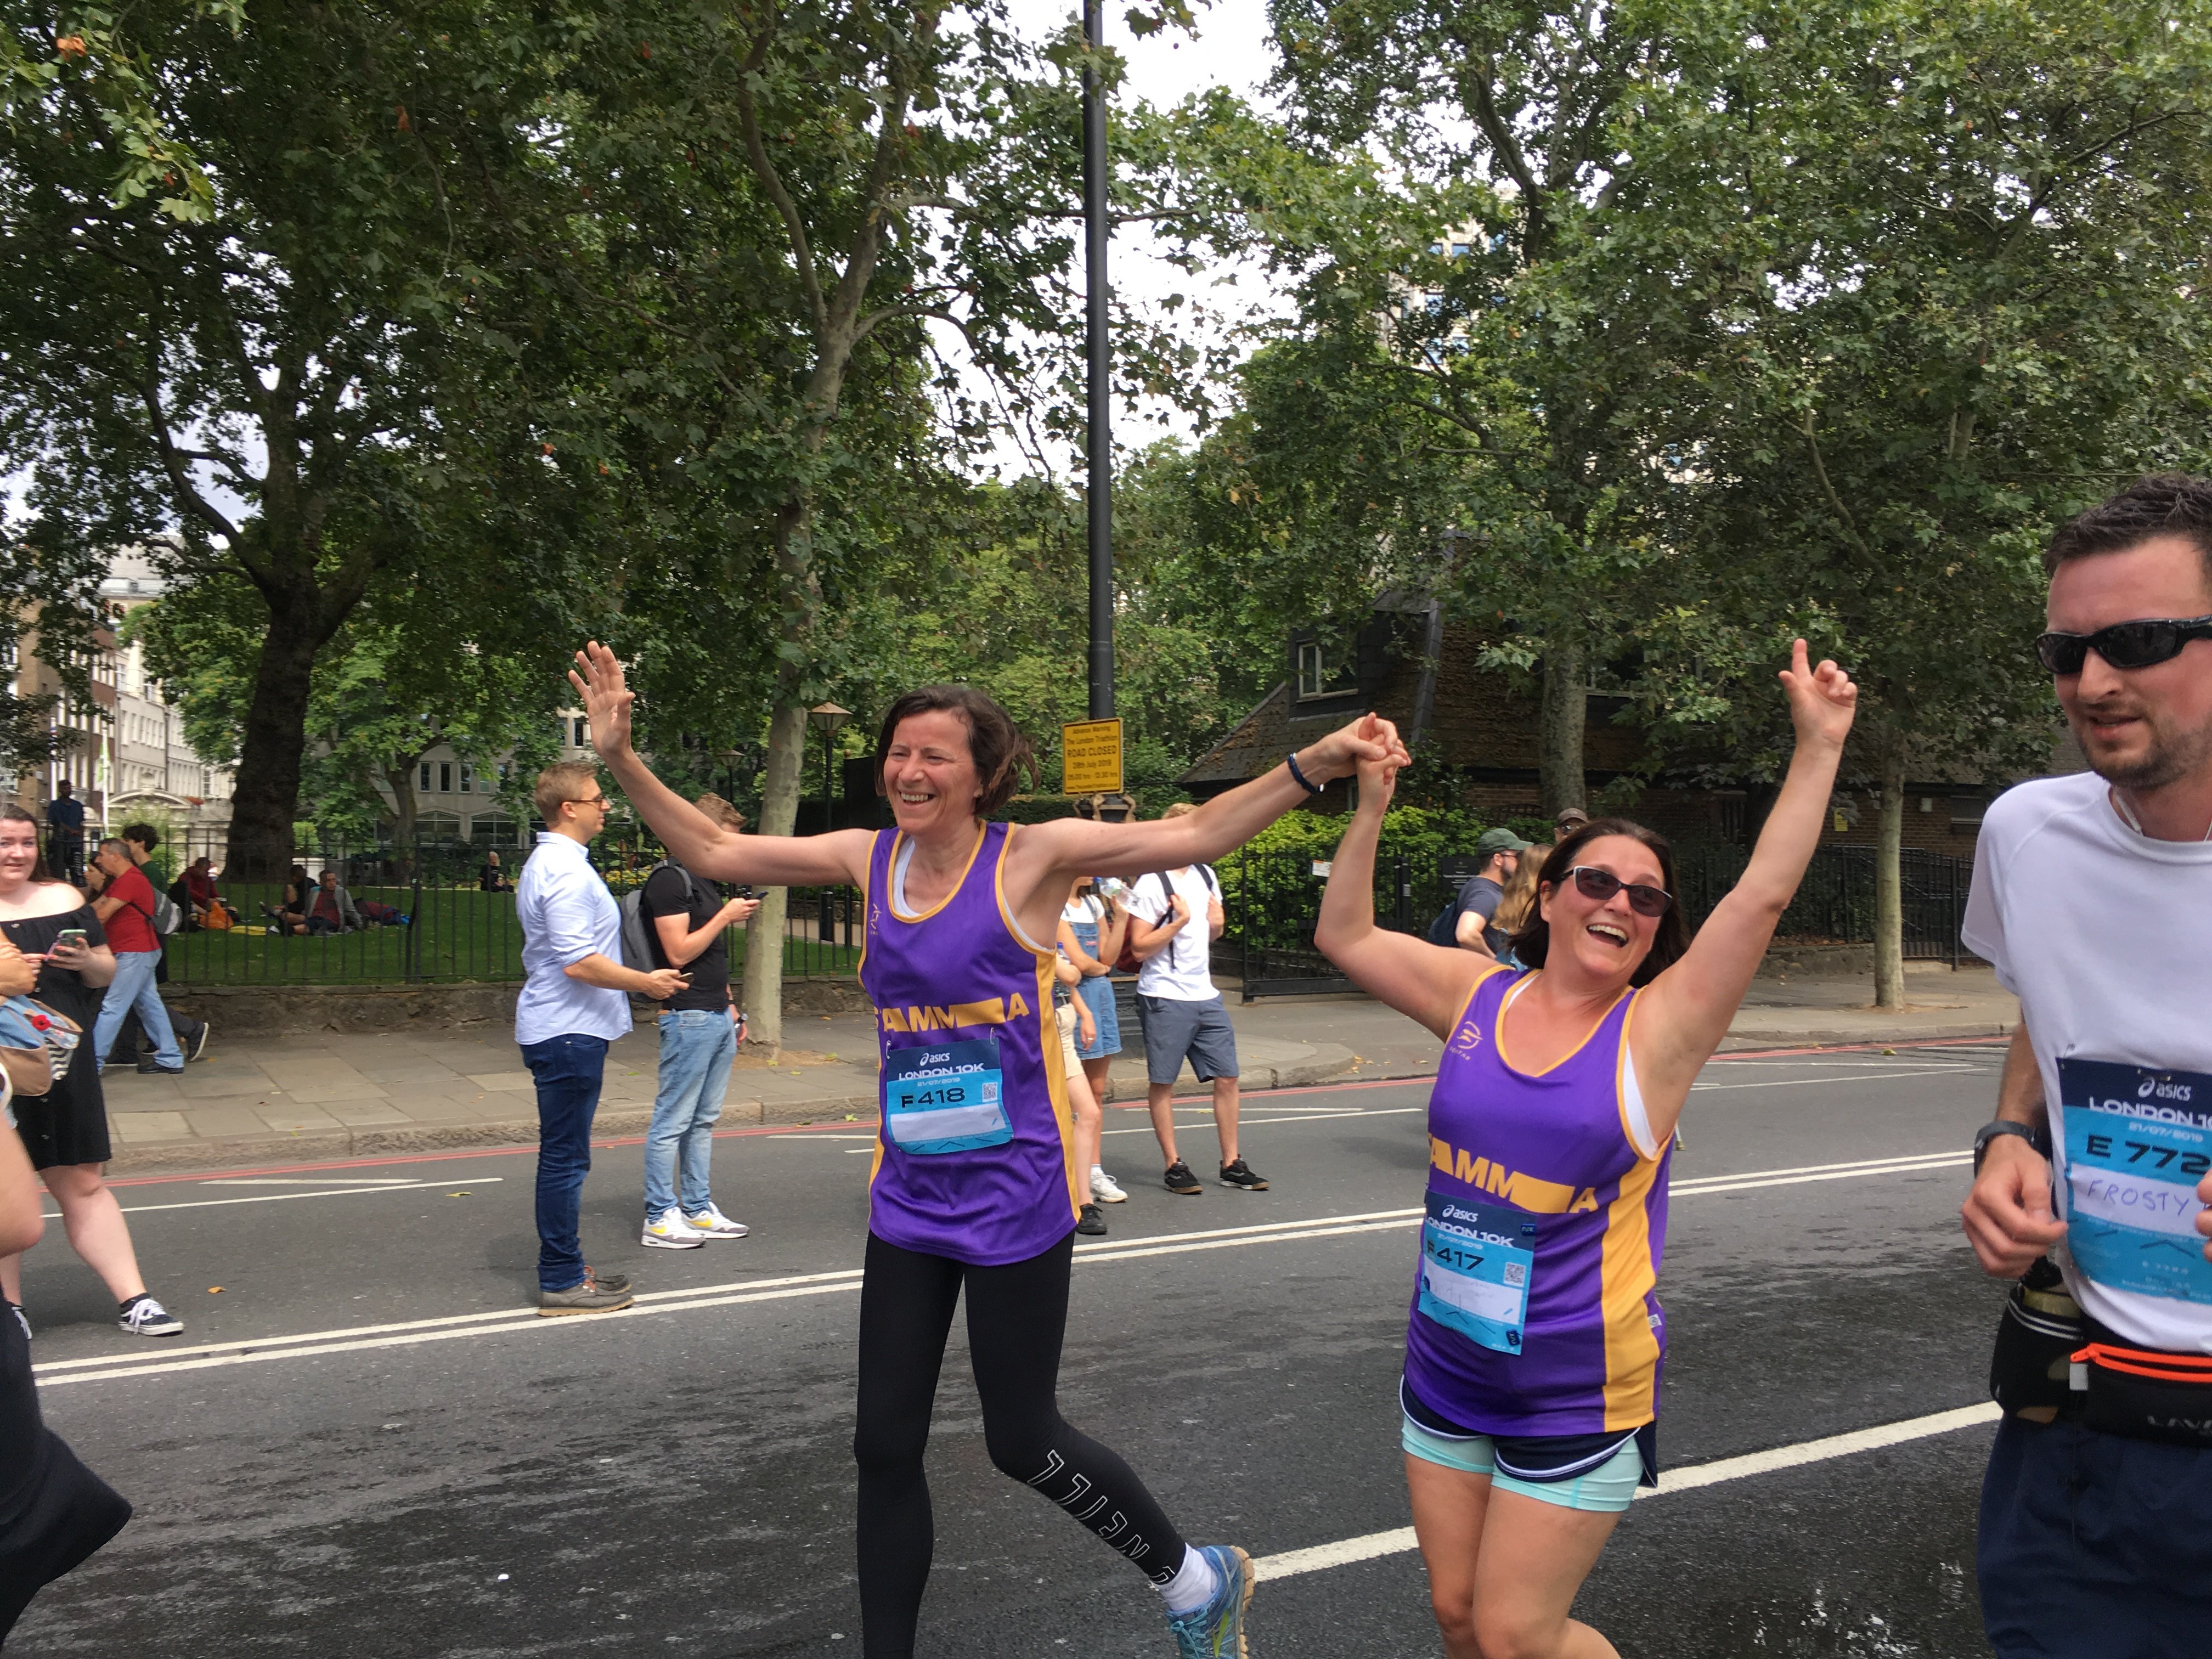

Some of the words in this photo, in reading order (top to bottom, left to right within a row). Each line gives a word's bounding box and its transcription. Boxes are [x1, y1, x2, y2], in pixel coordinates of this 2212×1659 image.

[1068, 748, 1087, 758] ROAD
[1088, 745, 1116, 756] CLOSED
[898, 1066, 953, 1081] LONDON
[955, 1062, 985, 1074] 10K
[917, 1076, 961, 1087] 21/07/2019
[917, 1087, 966, 1105] 418
[2089, 1096, 2194, 1126] LONDON
[2086, 1133, 2112, 1159] E
[2125, 1140, 2211, 1175] 772
[2087, 1179, 2190, 1216] FROSTY
[1480, 1232, 1515, 1249] 10K
[1436, 1247, 1485, 1271] 417
